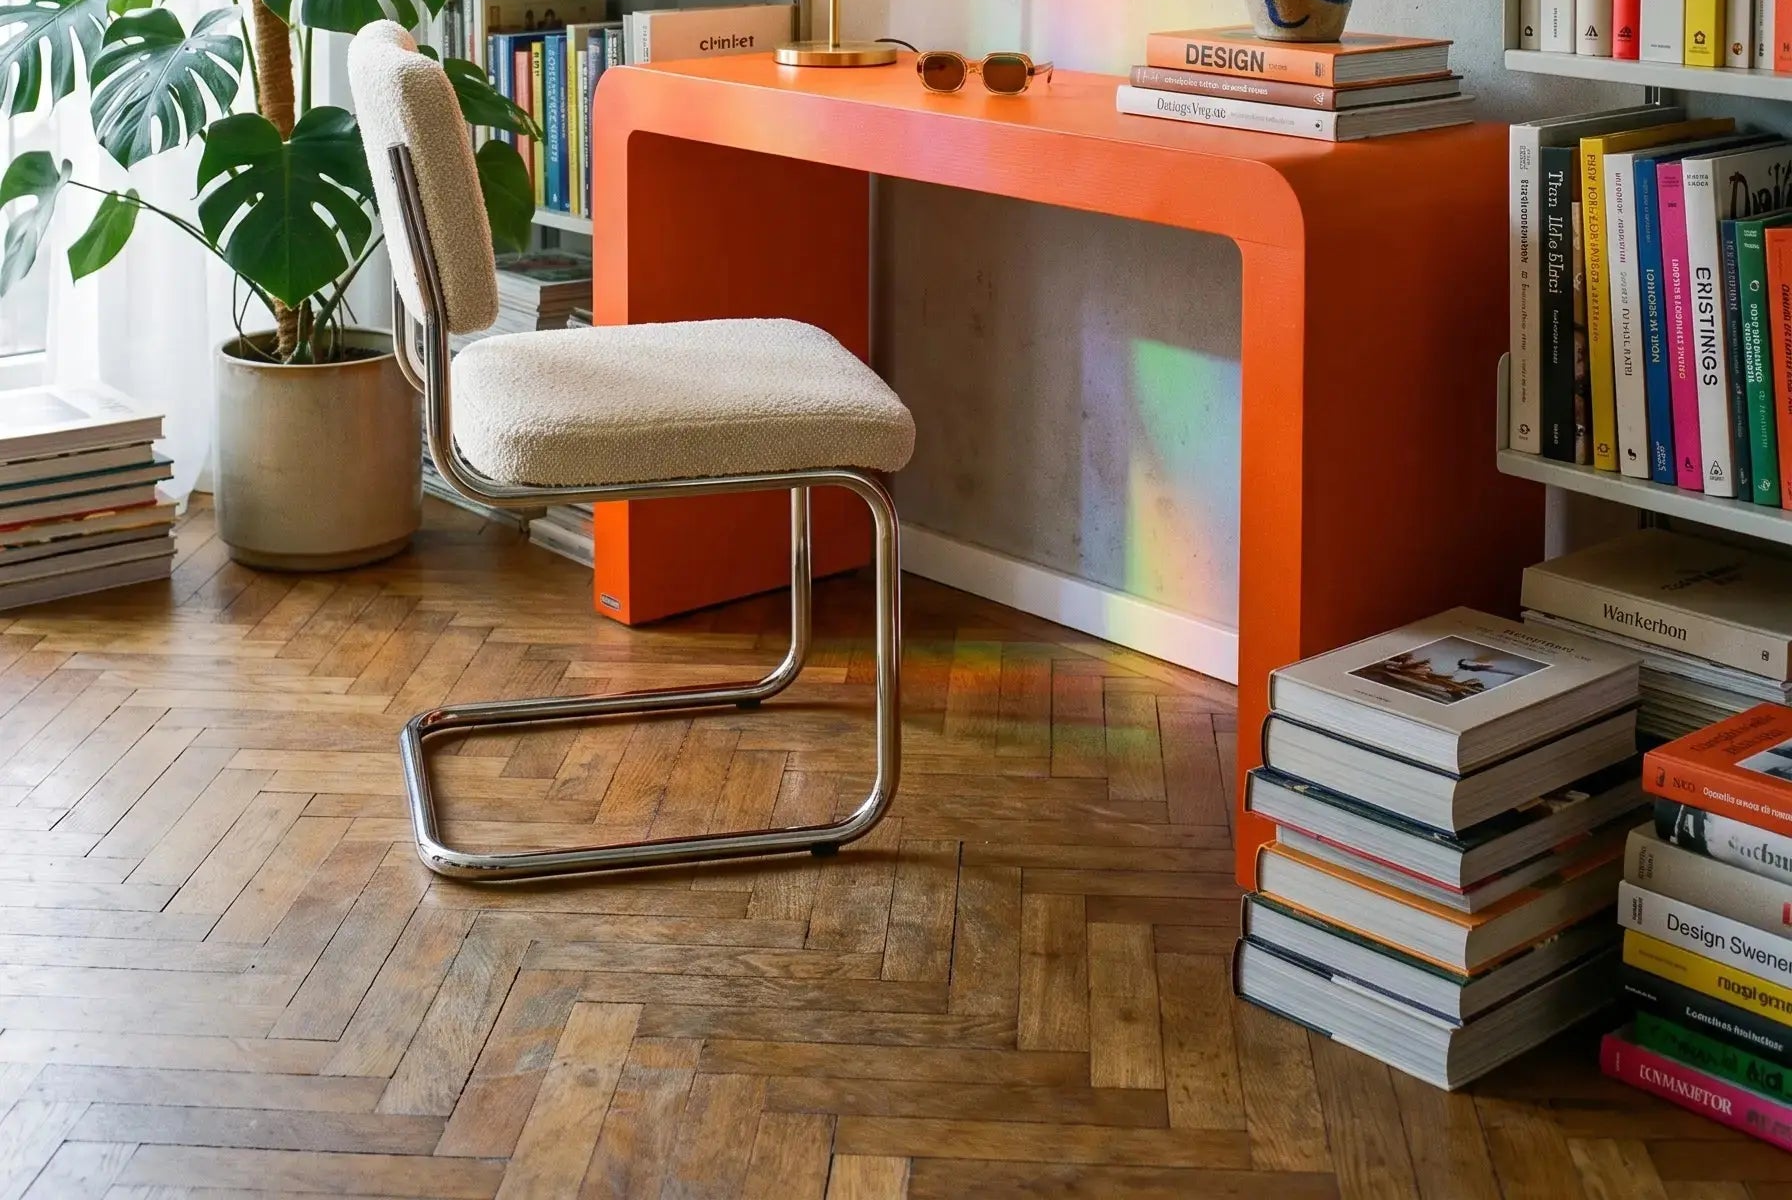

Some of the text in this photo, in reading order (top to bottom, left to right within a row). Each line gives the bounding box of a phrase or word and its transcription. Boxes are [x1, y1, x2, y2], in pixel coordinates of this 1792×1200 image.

[1185, 43, 1265, 73] DESIGN
[1603, 602, 1688, 641] Wankerbon
[1667, 912, 1725, 949] Design
